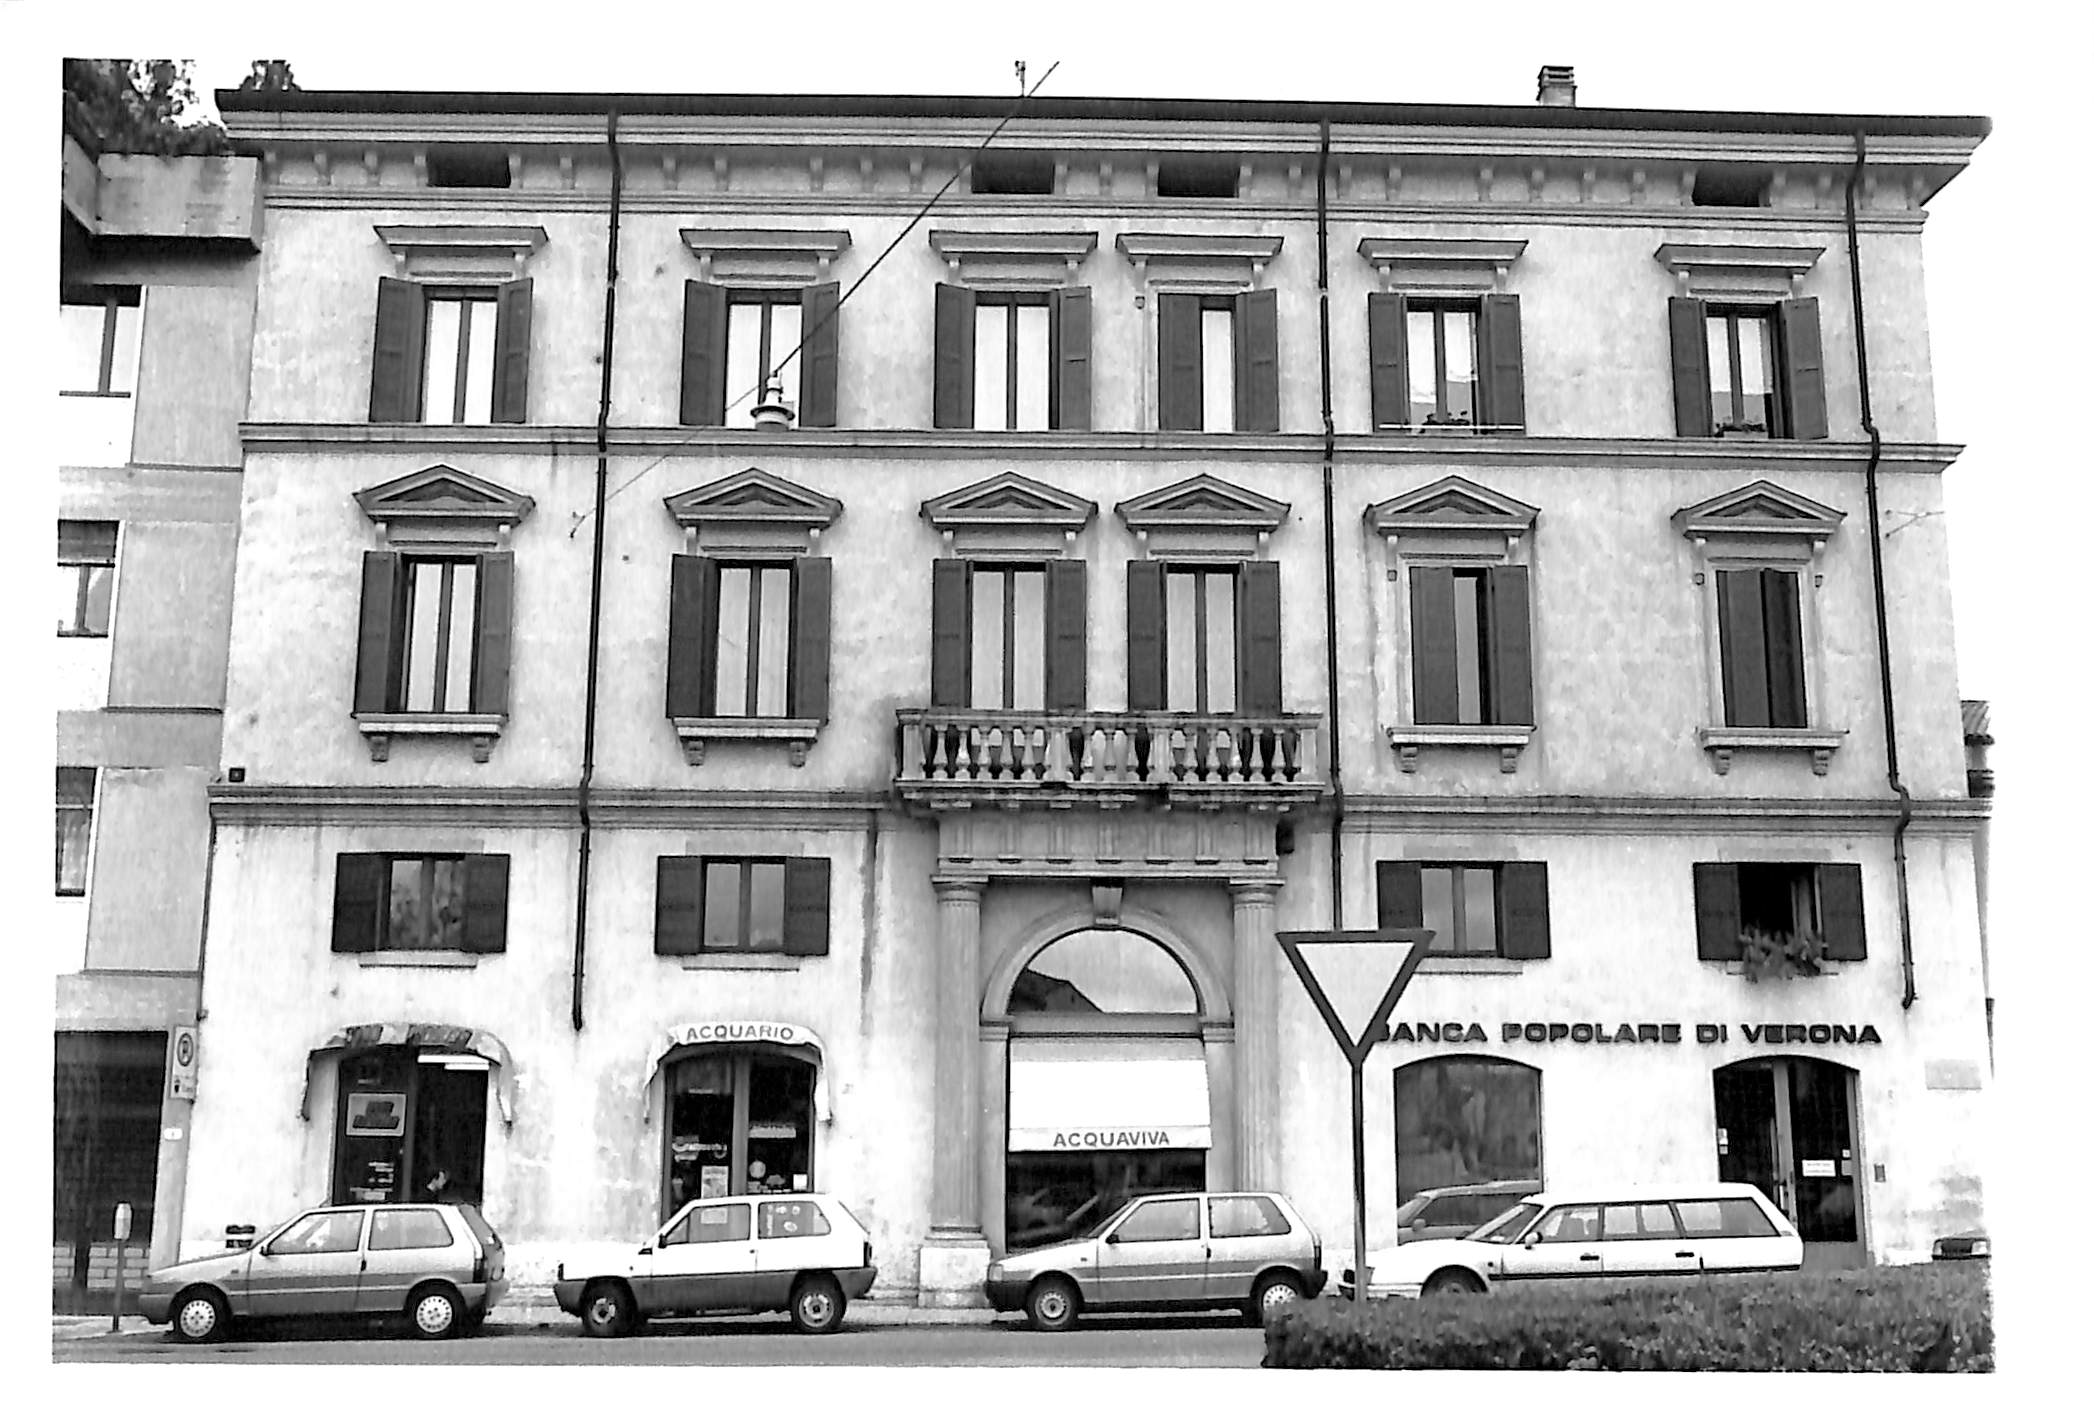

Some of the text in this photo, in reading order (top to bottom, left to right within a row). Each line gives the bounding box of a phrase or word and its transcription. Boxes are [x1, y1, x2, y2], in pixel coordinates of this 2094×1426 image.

[686, 1025, 794, 1041] ACQUARIO
[1502, 1022, 1682, 1043] POPOLARE
[1697, 1024, 1728, 1043] DI
[1741, 1024, 1882, 1044] VERONA
[1053, 1131, 1170, 1147] ACQUAVIVA
